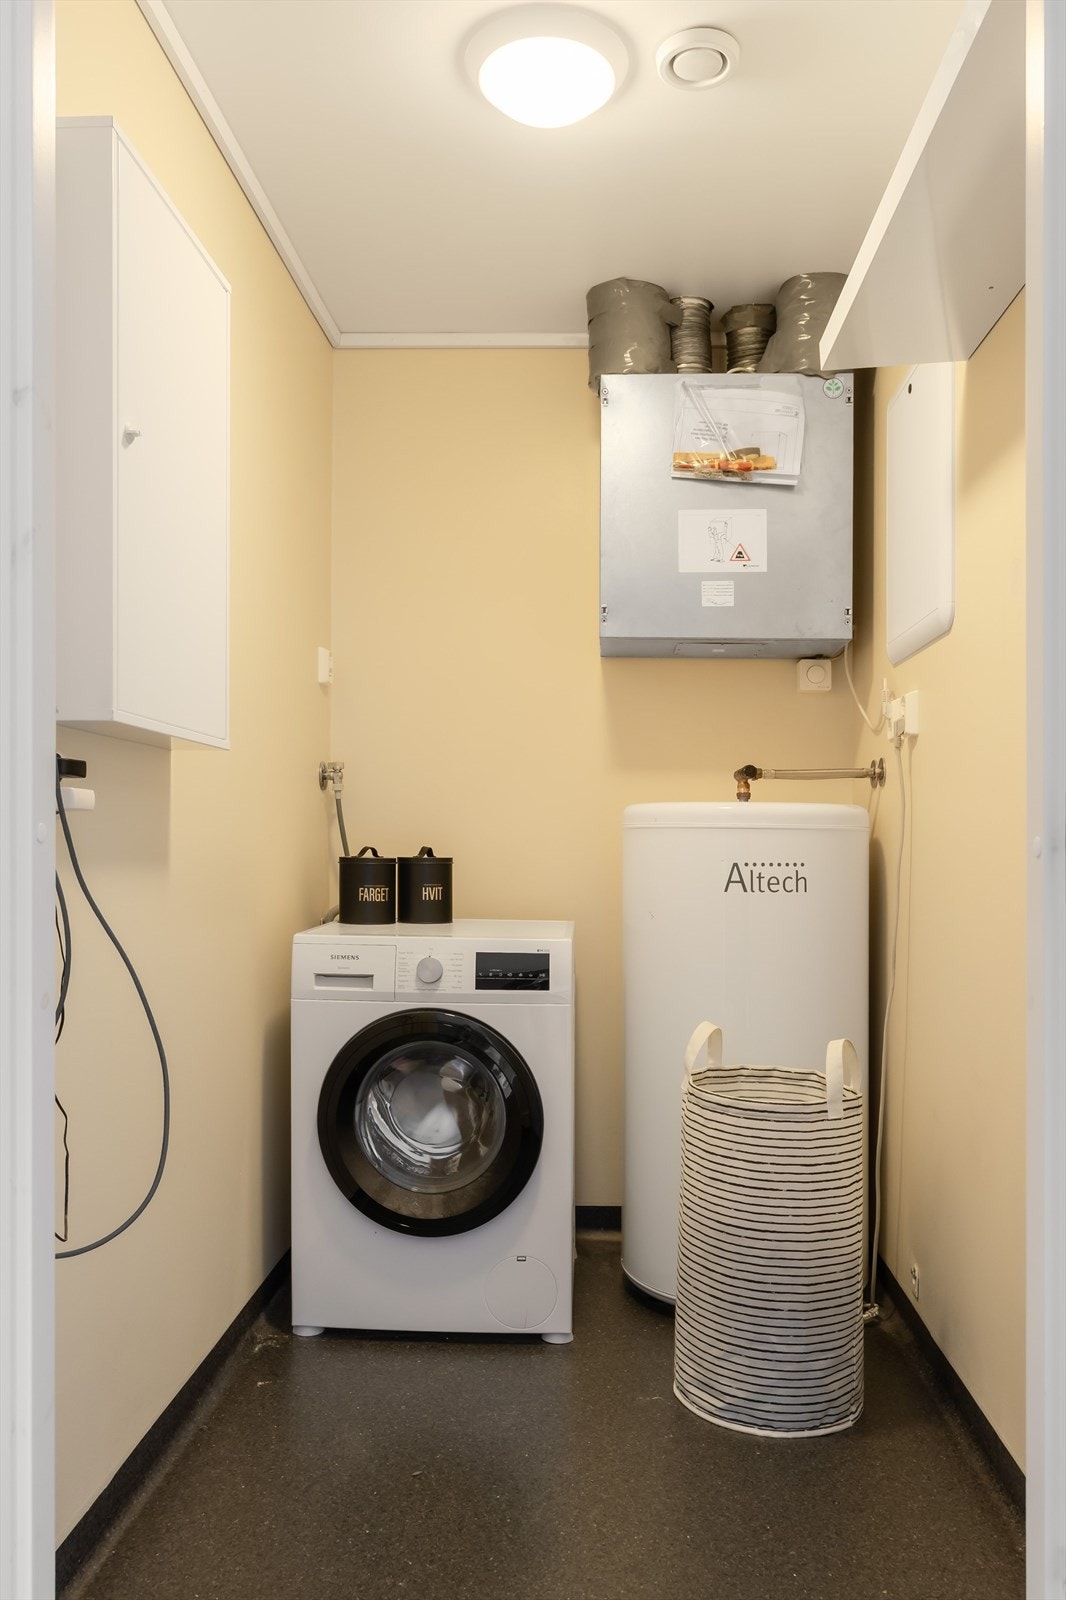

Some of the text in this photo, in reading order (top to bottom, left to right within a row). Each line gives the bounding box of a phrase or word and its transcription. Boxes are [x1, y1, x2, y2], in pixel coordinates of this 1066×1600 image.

[724, 862, 807, 893] Altech
[358, 887, 390, 902] FARGET
[422, 886, 443, 901] HVIT
